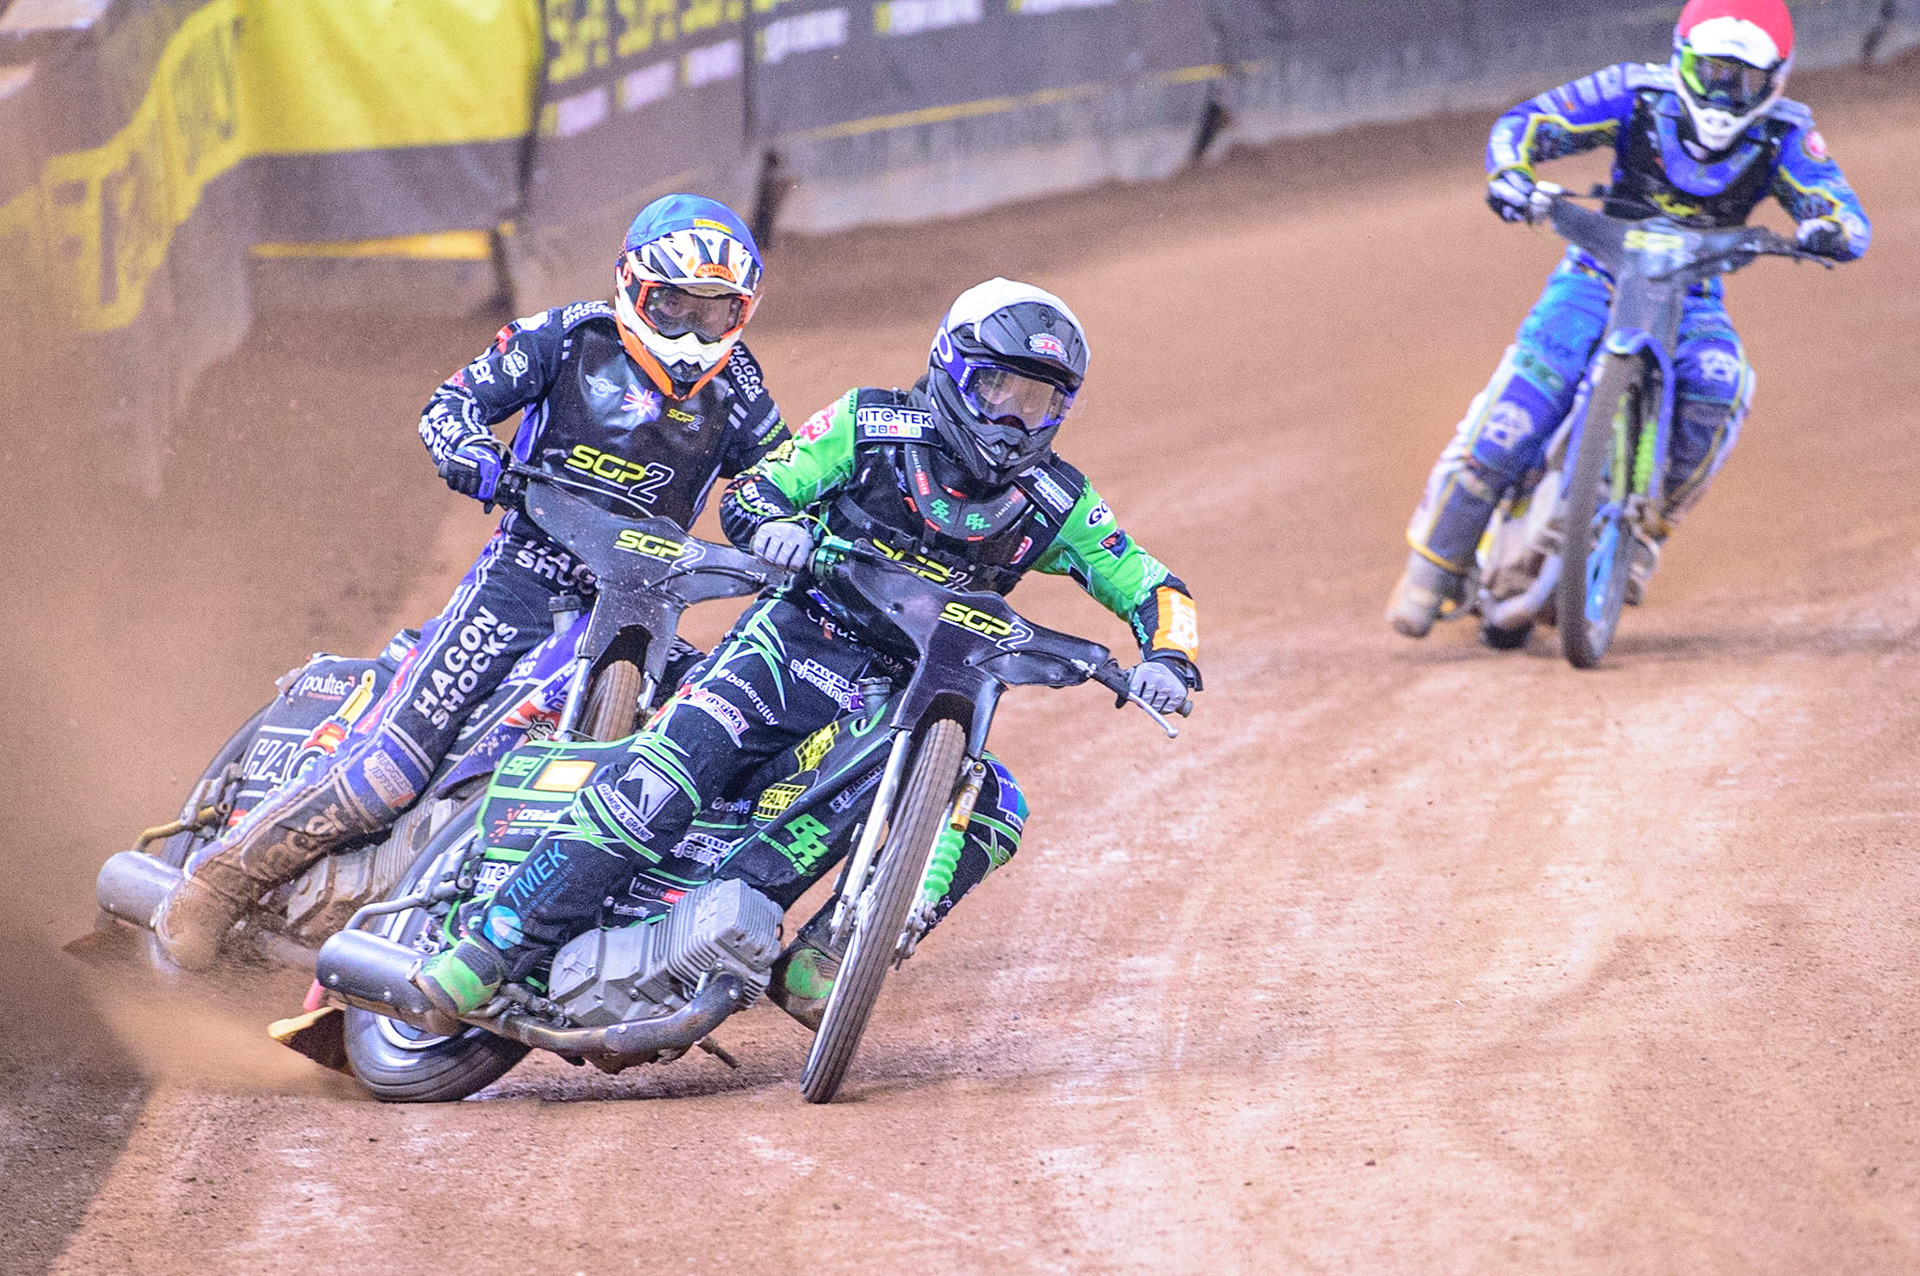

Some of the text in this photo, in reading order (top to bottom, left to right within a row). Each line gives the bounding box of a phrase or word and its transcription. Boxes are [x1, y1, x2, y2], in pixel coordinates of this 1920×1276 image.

[728, 356, 757, 402] HOCKS
[667, 408, 705, 431] SGP2
[566, 445, 675, 504] SGP2
[614, 529, 706, 575] SGP2
[939, 602, 1034, 657] SGP2
[413, 606, 498, 718] HAGON
[431, 623, 518, 730] SHOCKS
[706, 695, 742, 730] BYGMA
[727, 671, 779, 727] bakertilly
[375, 751, 411, 792] RUGGLES
[504, 840, 569, 908] TMEK
